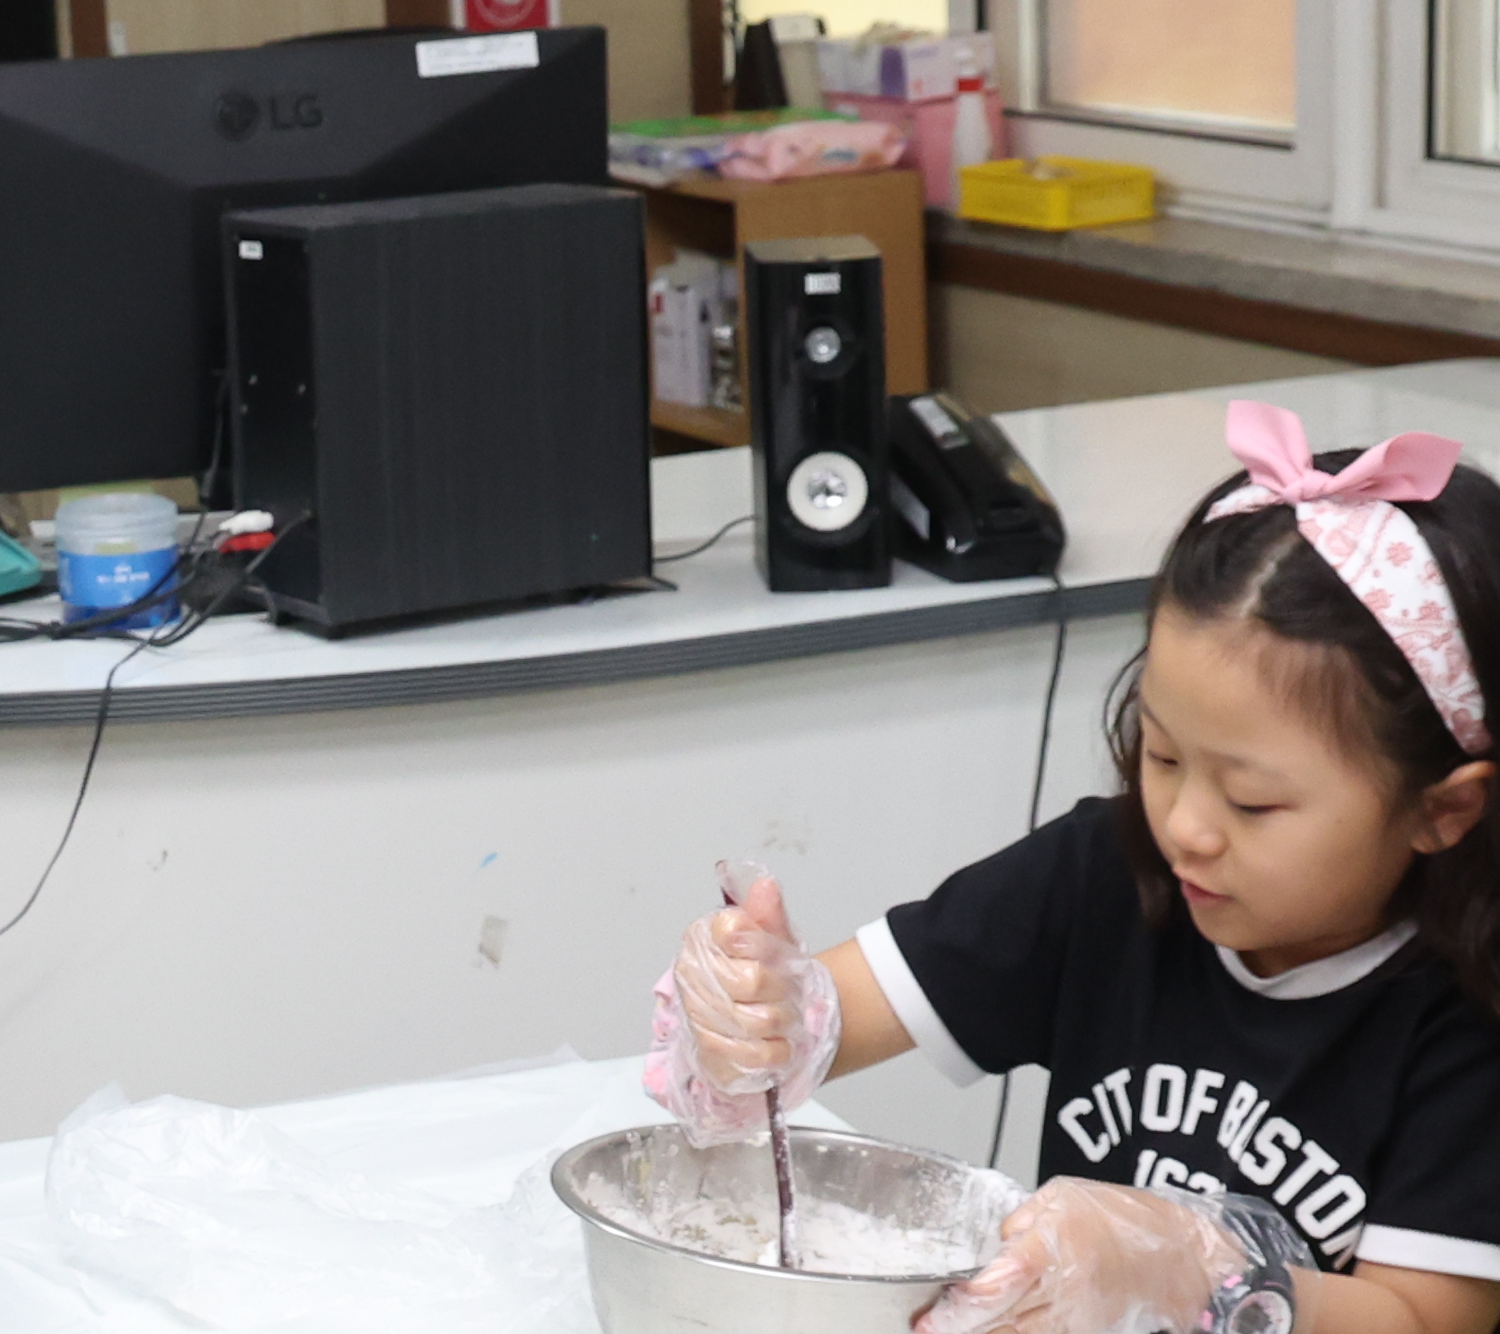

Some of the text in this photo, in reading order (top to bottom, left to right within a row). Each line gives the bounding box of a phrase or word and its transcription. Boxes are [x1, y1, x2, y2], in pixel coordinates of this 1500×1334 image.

[269, 93, 323, 130] LG
[1057, 1068, 1134, 1164] CIT
[1140, 1063, 1227, 1136] OF
